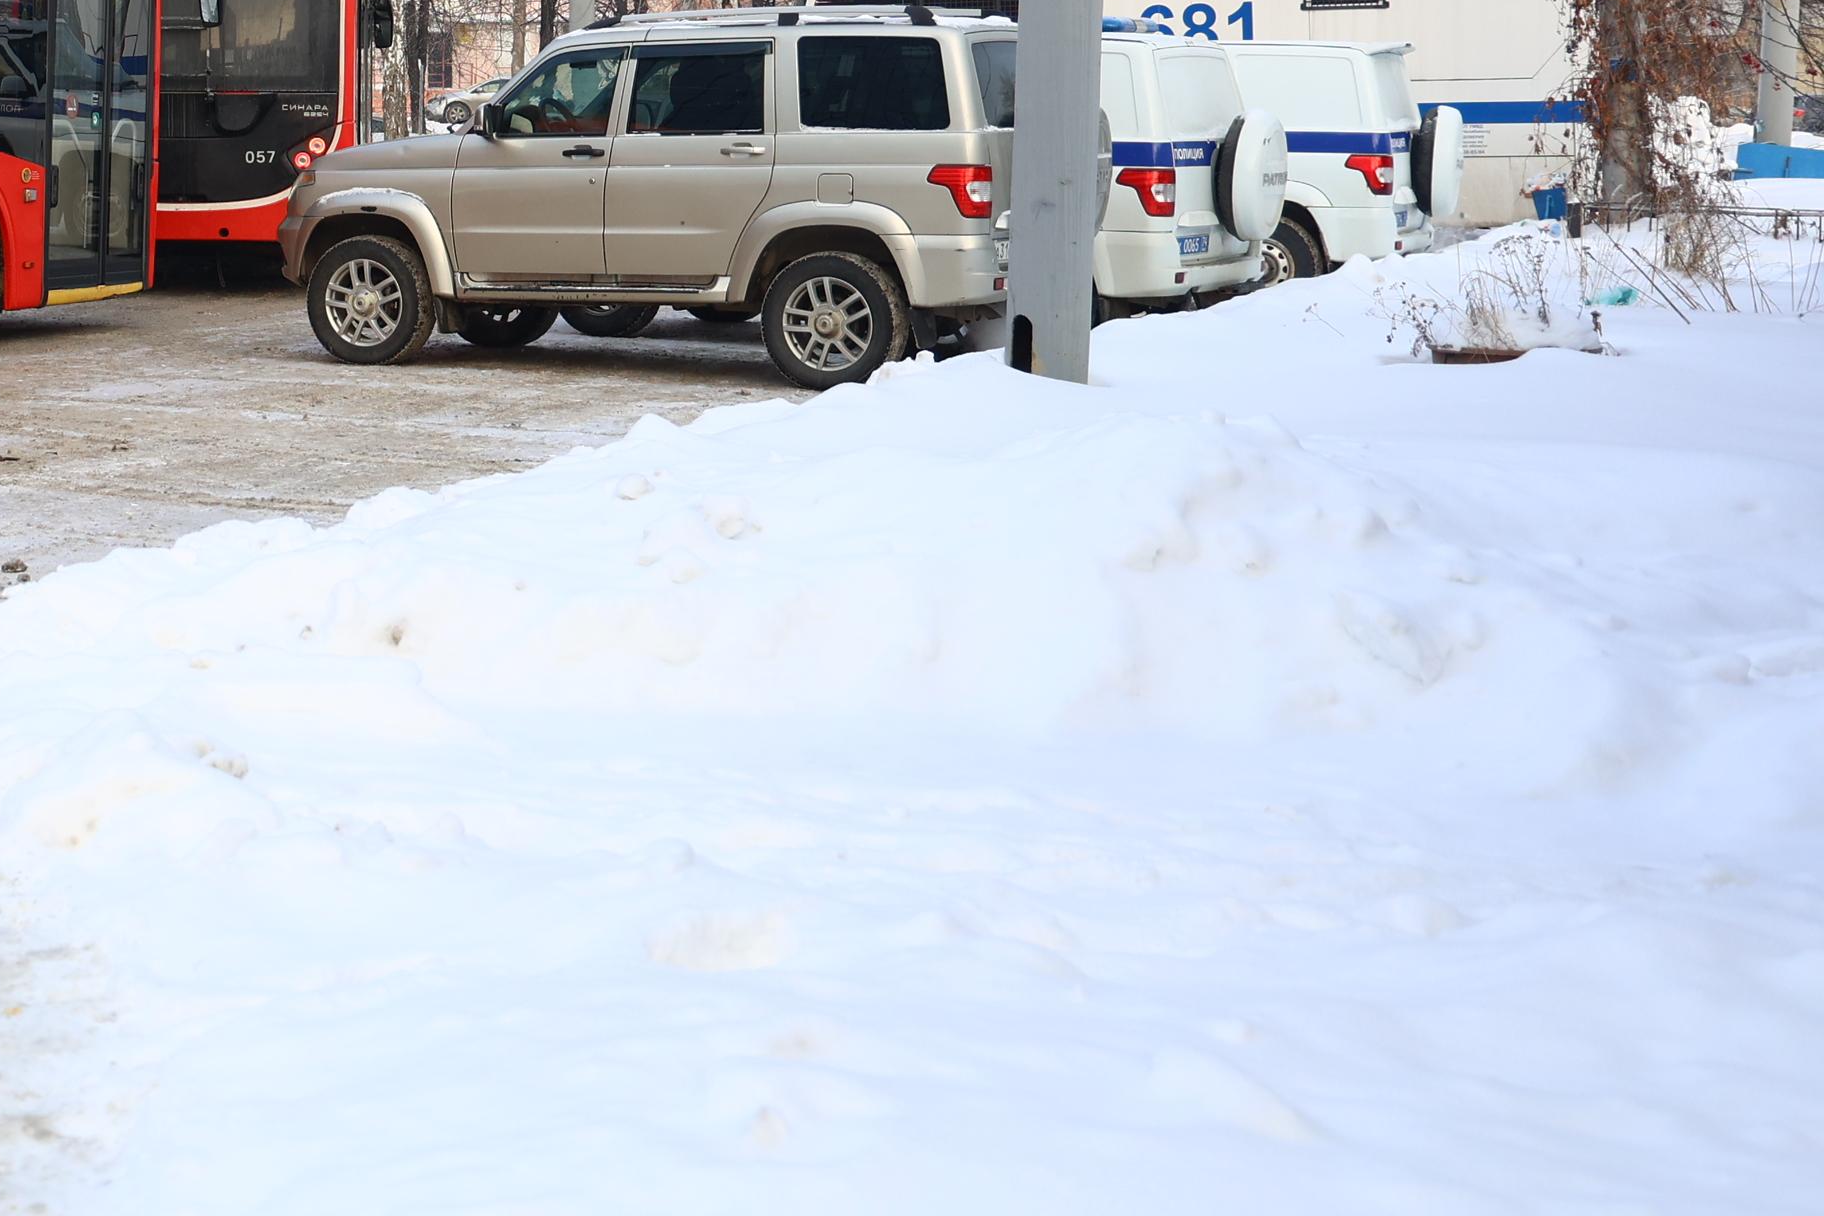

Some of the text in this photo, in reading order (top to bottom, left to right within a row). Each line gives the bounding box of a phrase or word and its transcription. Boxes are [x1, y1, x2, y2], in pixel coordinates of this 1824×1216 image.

[1141, 1, 1253, 41] 681
[245, 150, 276, 164] 057
[1173, 148, 1205, 160] ПОЛИЦИЯ
